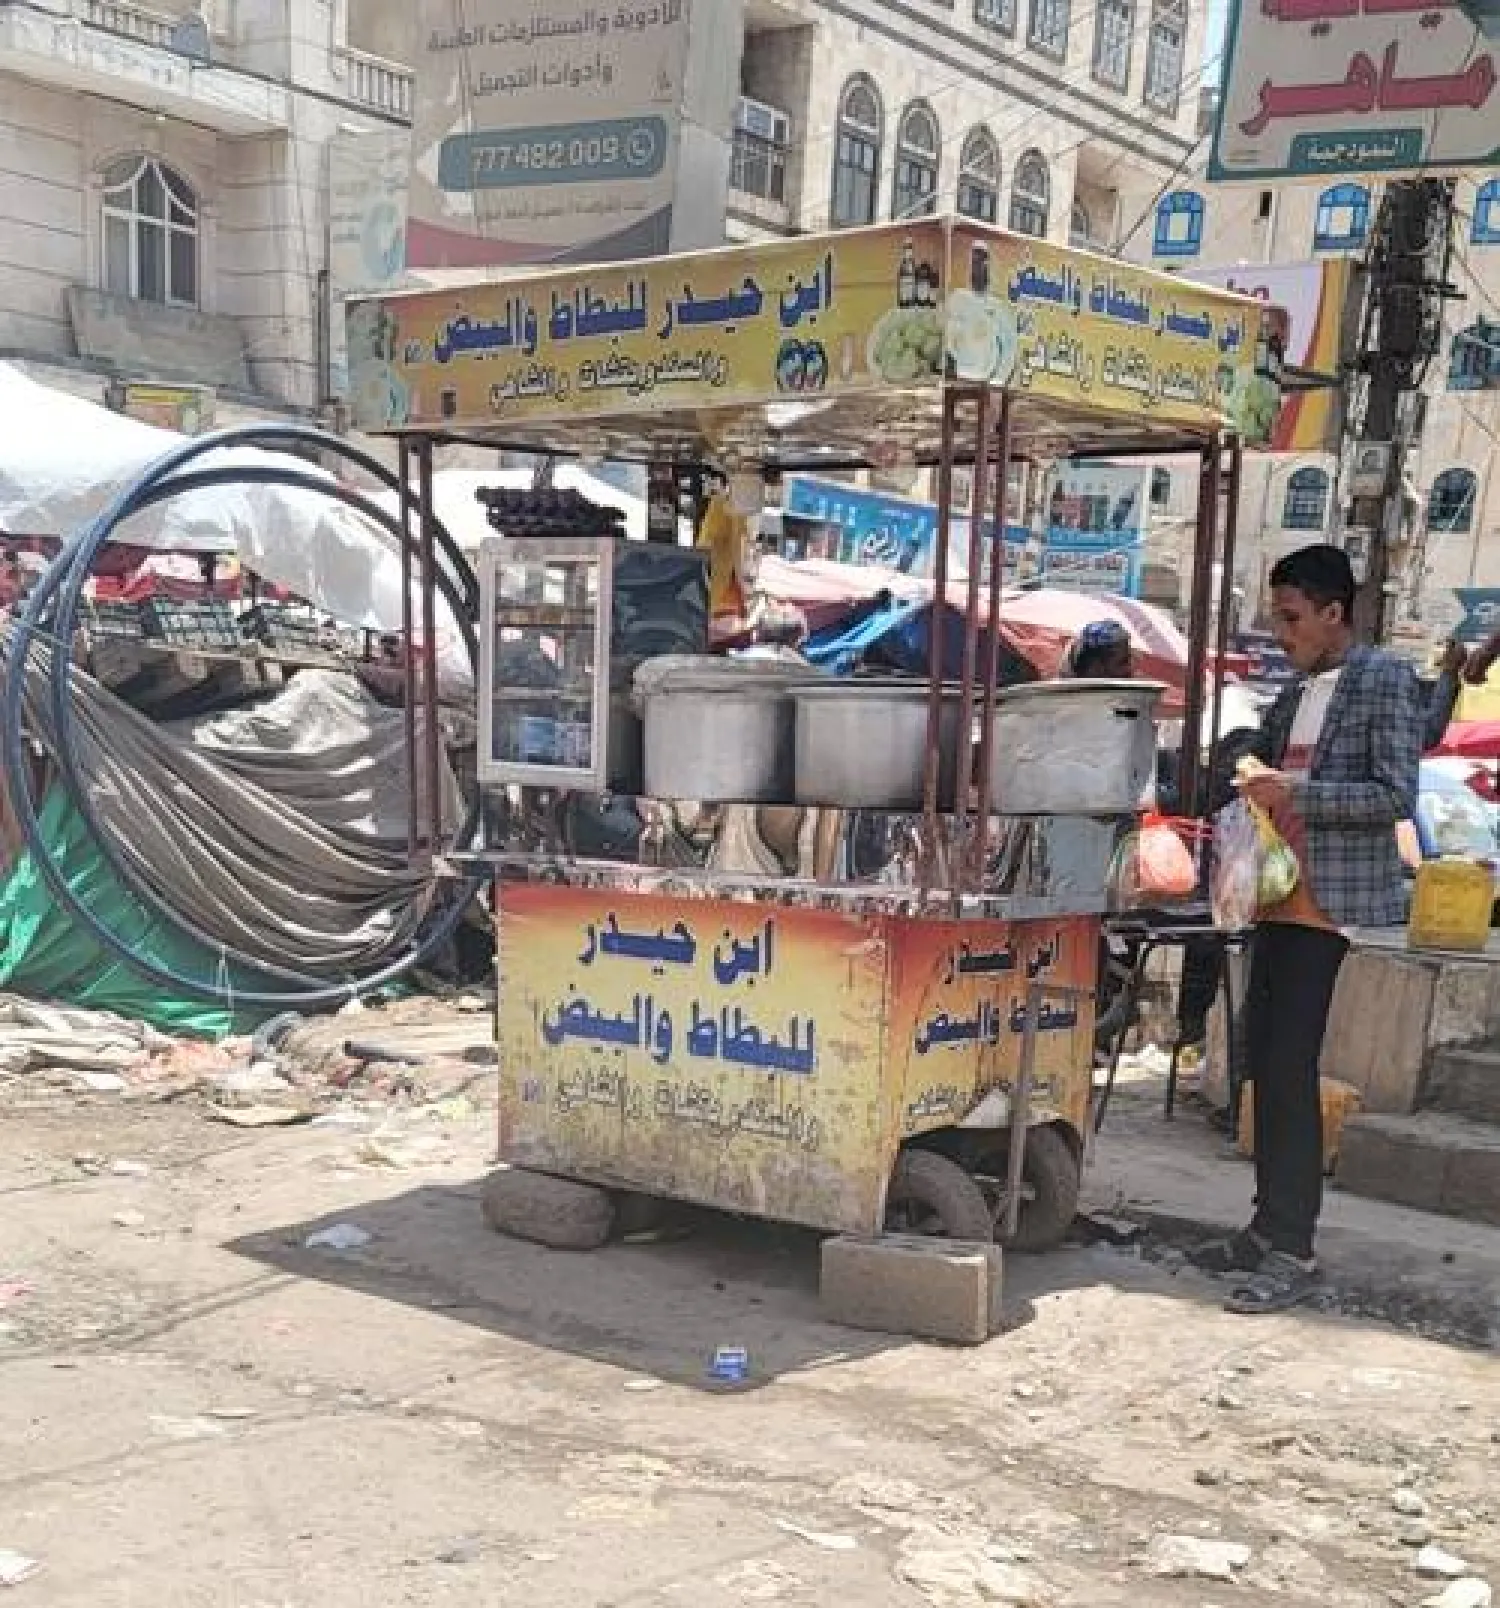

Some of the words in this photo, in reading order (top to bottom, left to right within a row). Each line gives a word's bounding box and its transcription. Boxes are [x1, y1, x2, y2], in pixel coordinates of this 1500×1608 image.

[1239, 40, 1498, 137] ماهر
[549, 279, 648, 345] للبطاط
[657, 276, 763, 339] حيدر
[779, 251, 832, 327] ابن
[1008, 264, 1081, 317] والبيض
[1088, 275, 1152, 325] للبطاط
[434, 300, 538, 363] والبيض
[1154, 303, 1213, 344] حيدر
[1218, 313, 1247, 352] ابن
[577, 911, 697, 975] حيدر
[713, 917, 773, 986] ابن
[944, 940, 1018, 985] حيدر
[1026, 932, 1060, 979] ابن
[543, 983, 673, 1065] والبيض
[686, 998, 815, 1081] للبطاط
[914, 999, 1000, 1054] والبيض
